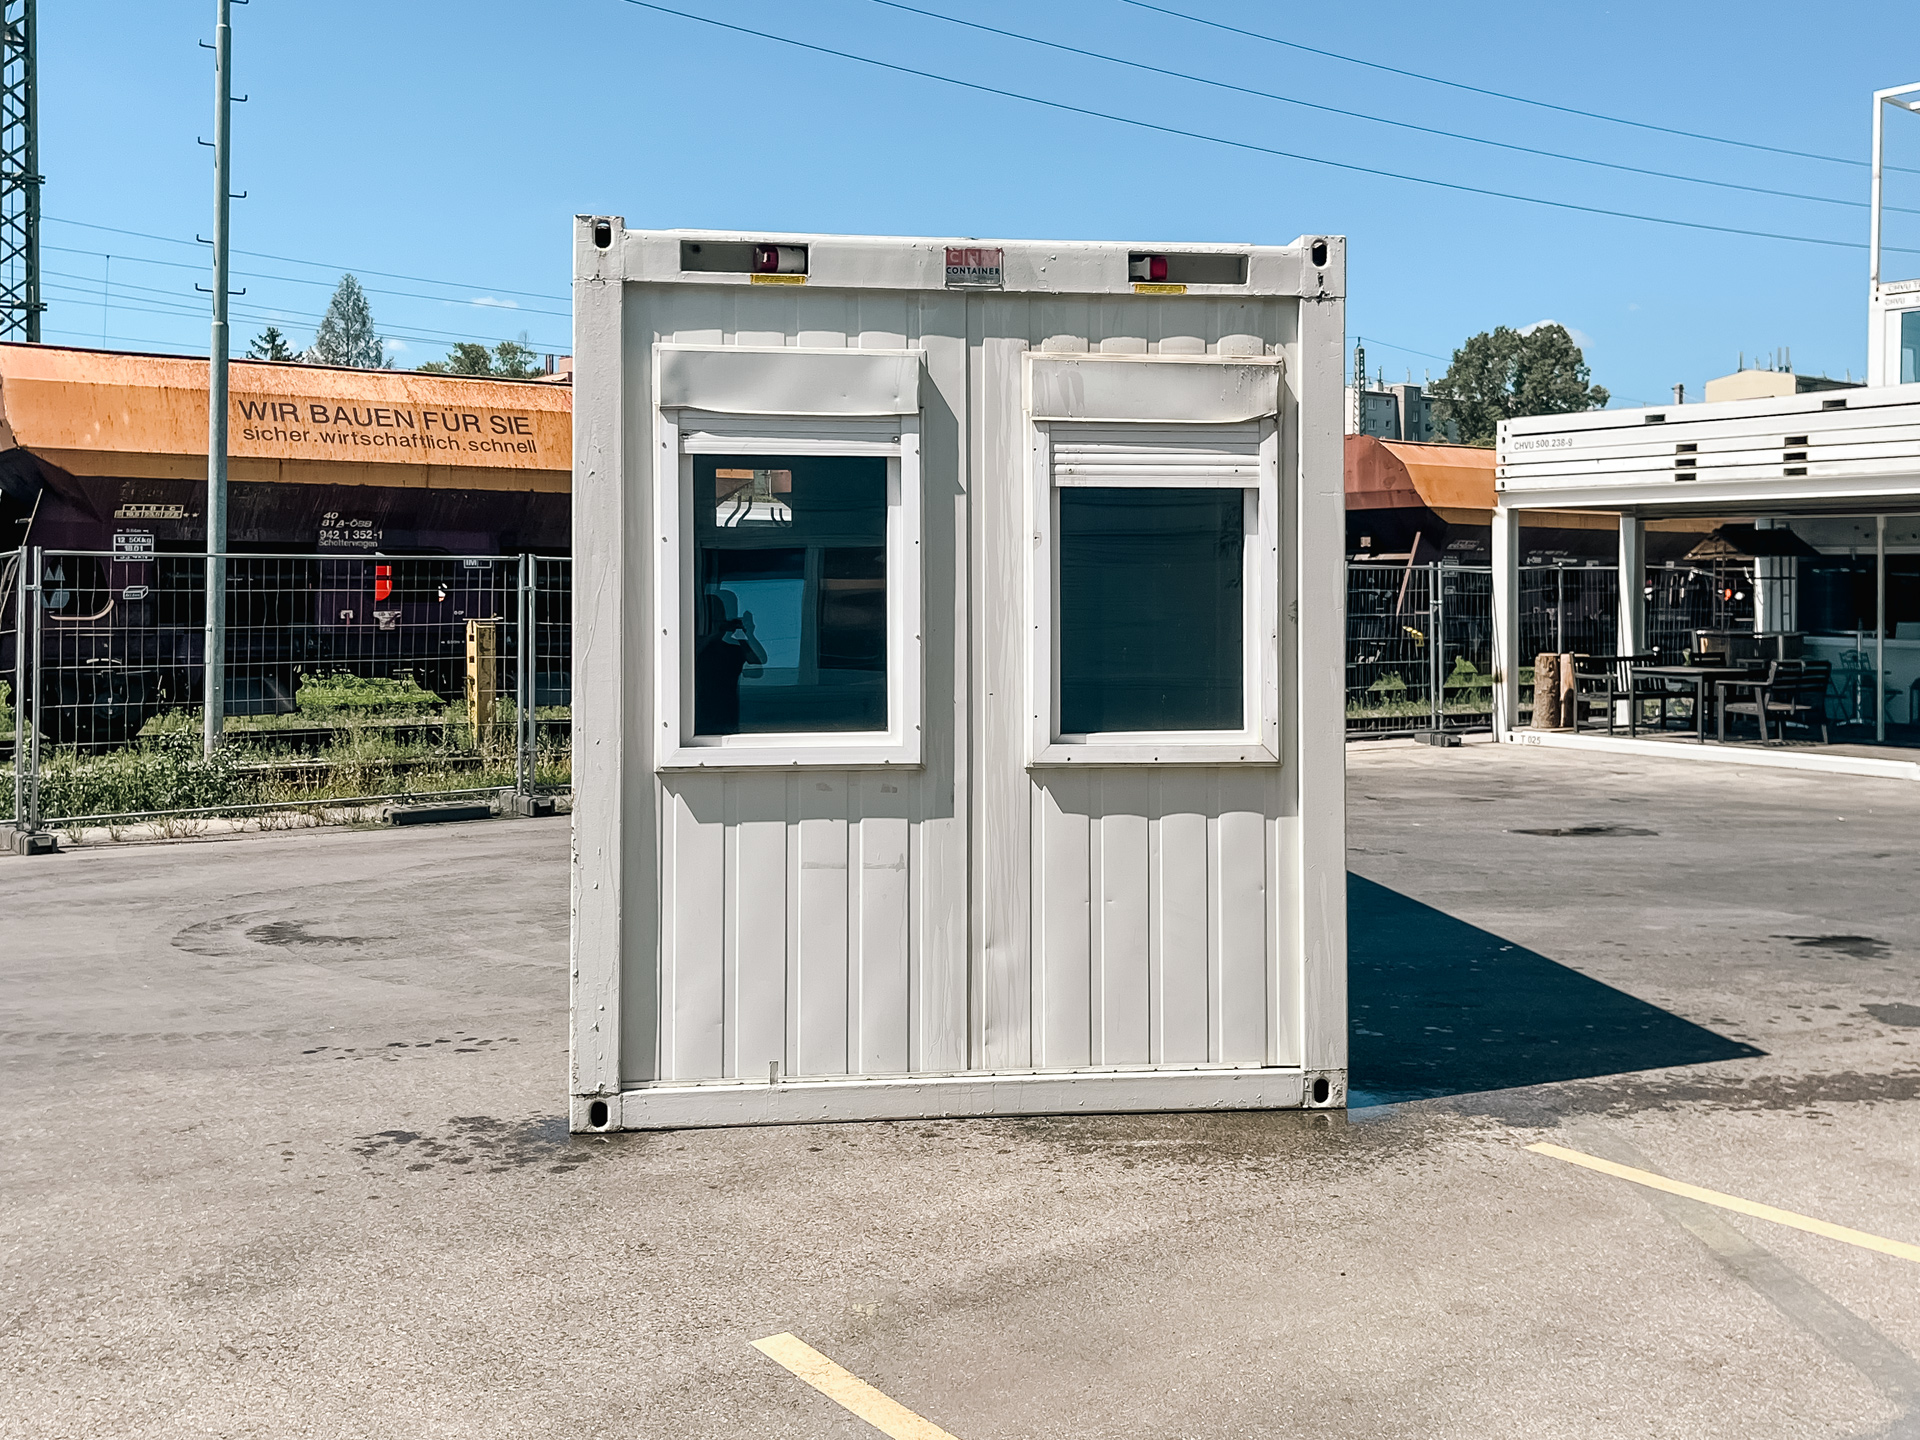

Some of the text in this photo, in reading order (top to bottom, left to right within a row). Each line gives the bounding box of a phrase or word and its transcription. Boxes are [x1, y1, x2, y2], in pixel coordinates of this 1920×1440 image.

[946, 266, 1000, 275] CONTAINER
[238, 400, 533, 435] WIR BAUEN FÜR SIE
[1514, 441, 1534, 450] CHVU
[323, 511, 339, 519] 40
[319, 530, 383, 539] 942 1 352-1
